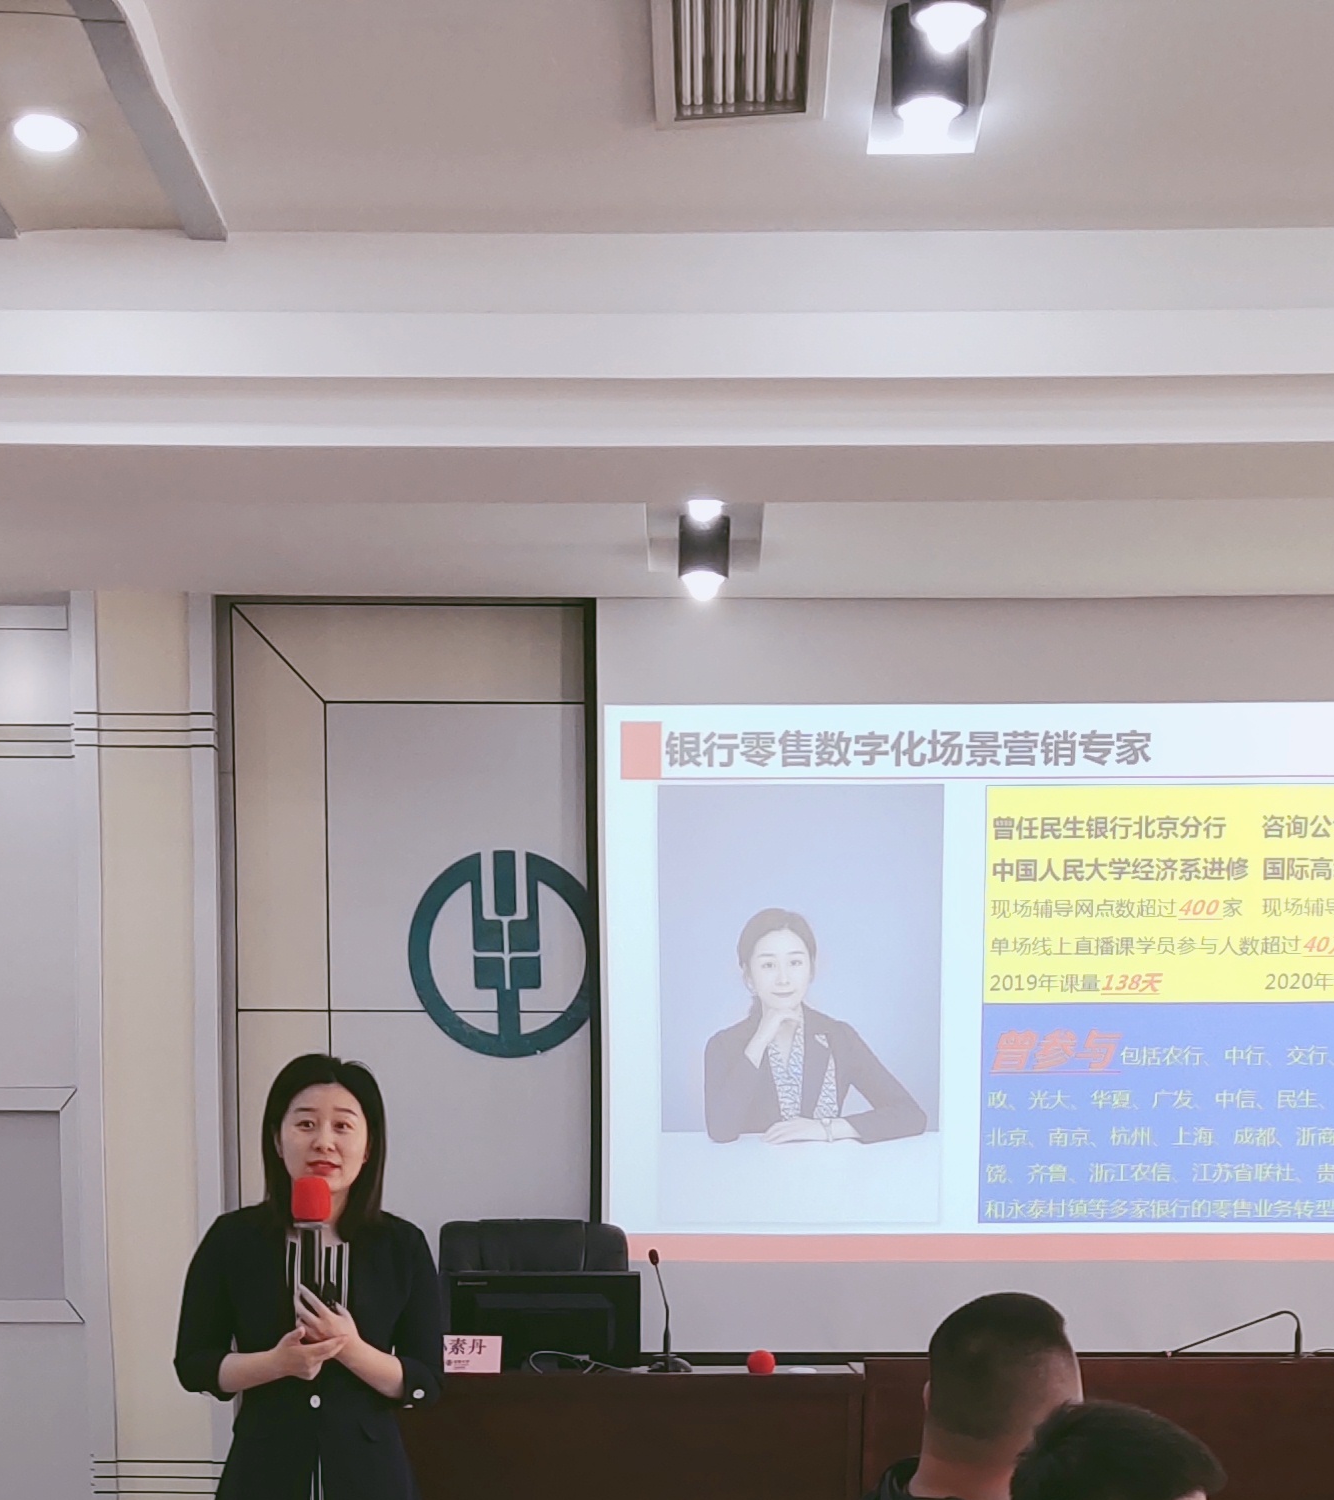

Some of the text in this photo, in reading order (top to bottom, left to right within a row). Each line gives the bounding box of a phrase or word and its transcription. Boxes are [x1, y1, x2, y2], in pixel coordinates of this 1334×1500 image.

[665, 730, 1152, 767] 银行零售数字化场景营销专家
[992, 816, 1227, 840] 曾任民生银行北京分行
[992, 857, 1248, 882] 中国人民大学经济系进修
[444, 1338, 487, 1355] 素丹
